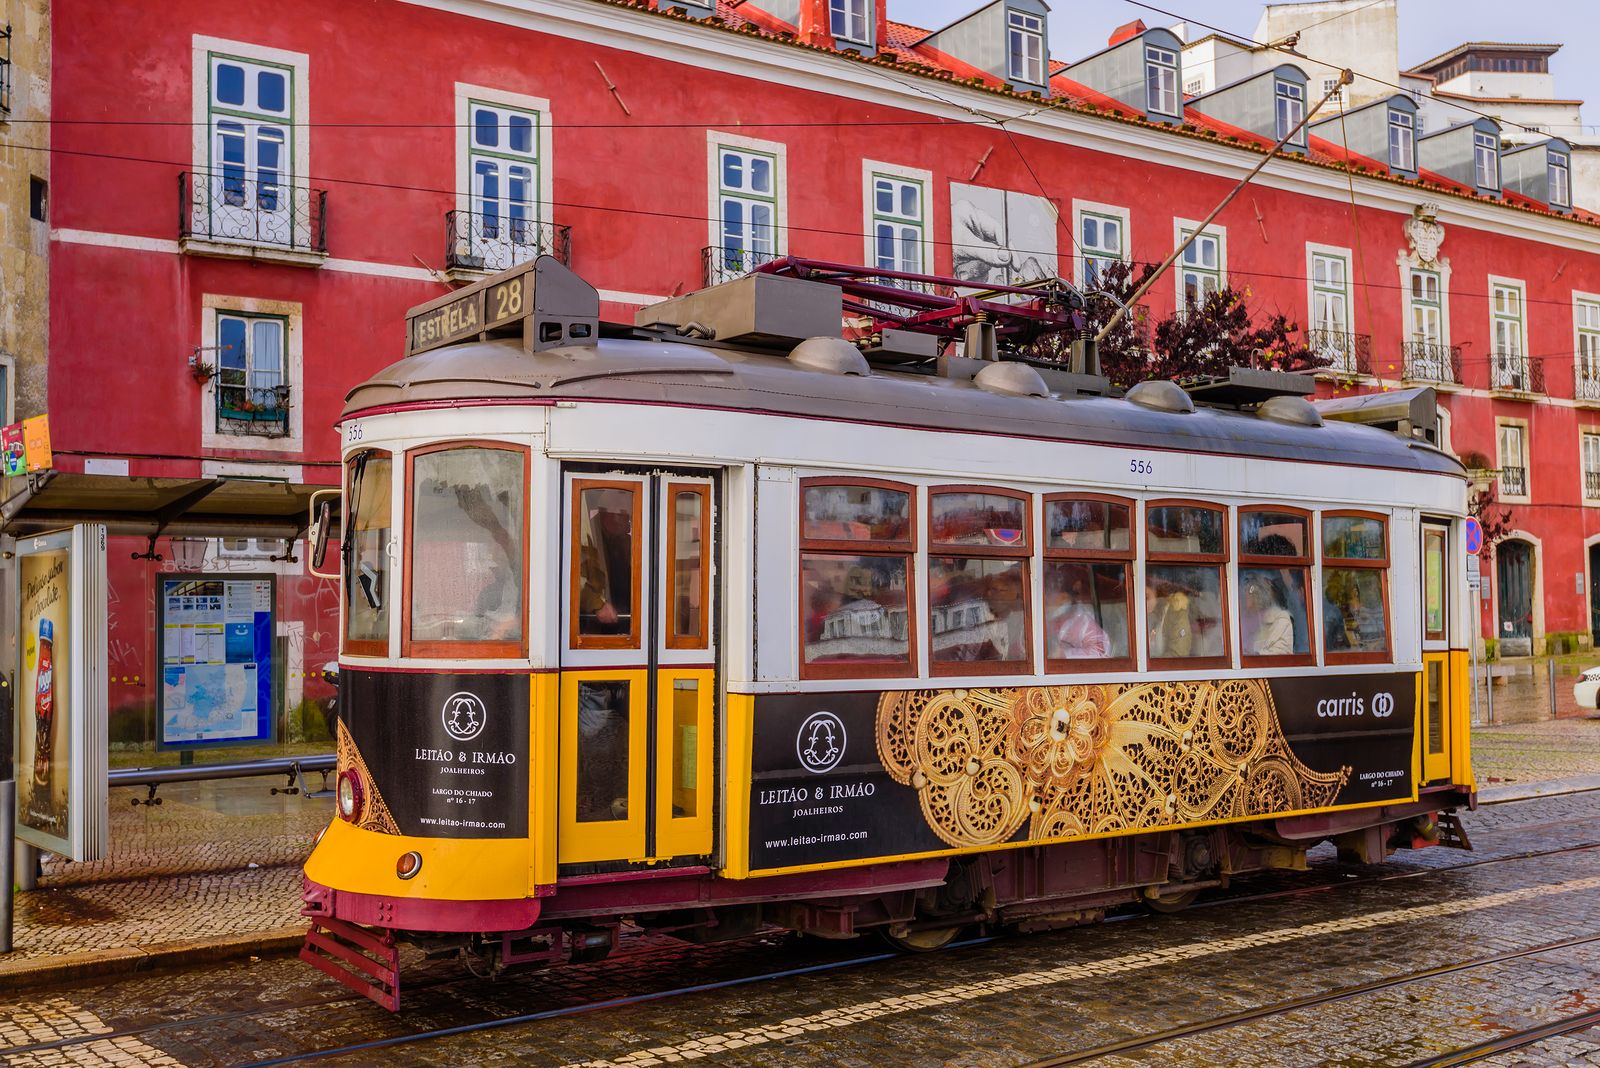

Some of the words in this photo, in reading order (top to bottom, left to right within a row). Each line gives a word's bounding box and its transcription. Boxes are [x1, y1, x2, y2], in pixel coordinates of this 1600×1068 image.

[496, 279, 522, 320] 28
[418, 303, 477, 341] ESTRELA
[348, 424, 363, 442] 556
[1130, 459, 1153, 474] 556
[1317, 691, 1364, 717] carris
[415, 748, 453, 762] LEITÃO
[459, 751, 467, 762] &
[472, 751, 516, 764] IRMÃO
[440, 767, 485, 775] JOALHEIROS
[1359, 771, 1376, 781] LARGO
[1376, 771, 1384, 779] DO
[1384, 769, 1405, 779] CHIADO
[432, 788, 453, 796] LARGO
[465, 789, 493, 797] CHIADO
[760, 787, 808, 805] LEITÃO
[815, 787, 824, 800] &
[830, 782, 875, 799] IRMÃO
[793, 806, 844, 818] JOALHEIROS
[420, 817, 506, 829] www.leitao-irmao.com
[765, 830, 868, 848] www.leitao-irmao.com
